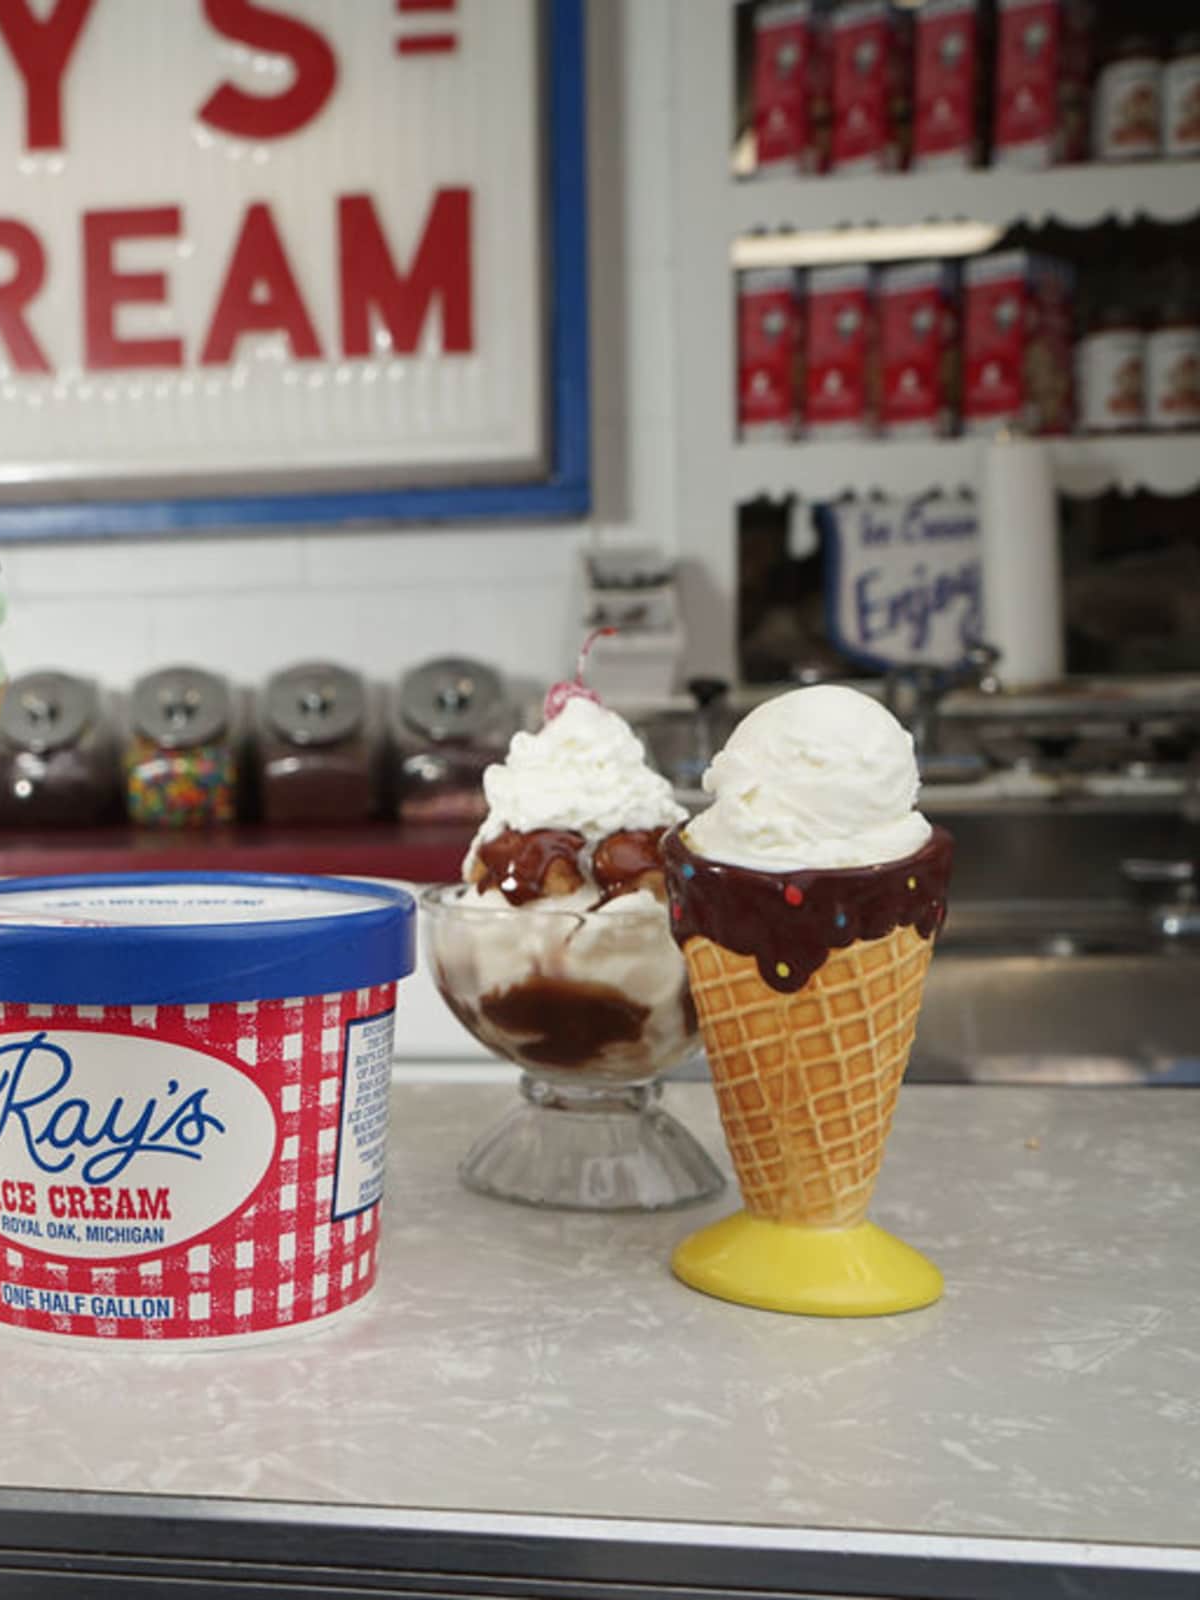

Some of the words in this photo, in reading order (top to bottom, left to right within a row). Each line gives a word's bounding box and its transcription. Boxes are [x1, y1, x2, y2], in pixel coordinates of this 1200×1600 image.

[47, 1185, 172, 1221] CREAM
[1, 1215, 43, 1238] ROYAL
[47, 1222, 81, 1243] OAK,
[86, 1225, 165, 1244] MICHIGAN
[3, 1284, 35, 1308] ONE
[39, 1291, 86, 1315] HALF
[91, 1296, 171, 1319] GALLON
